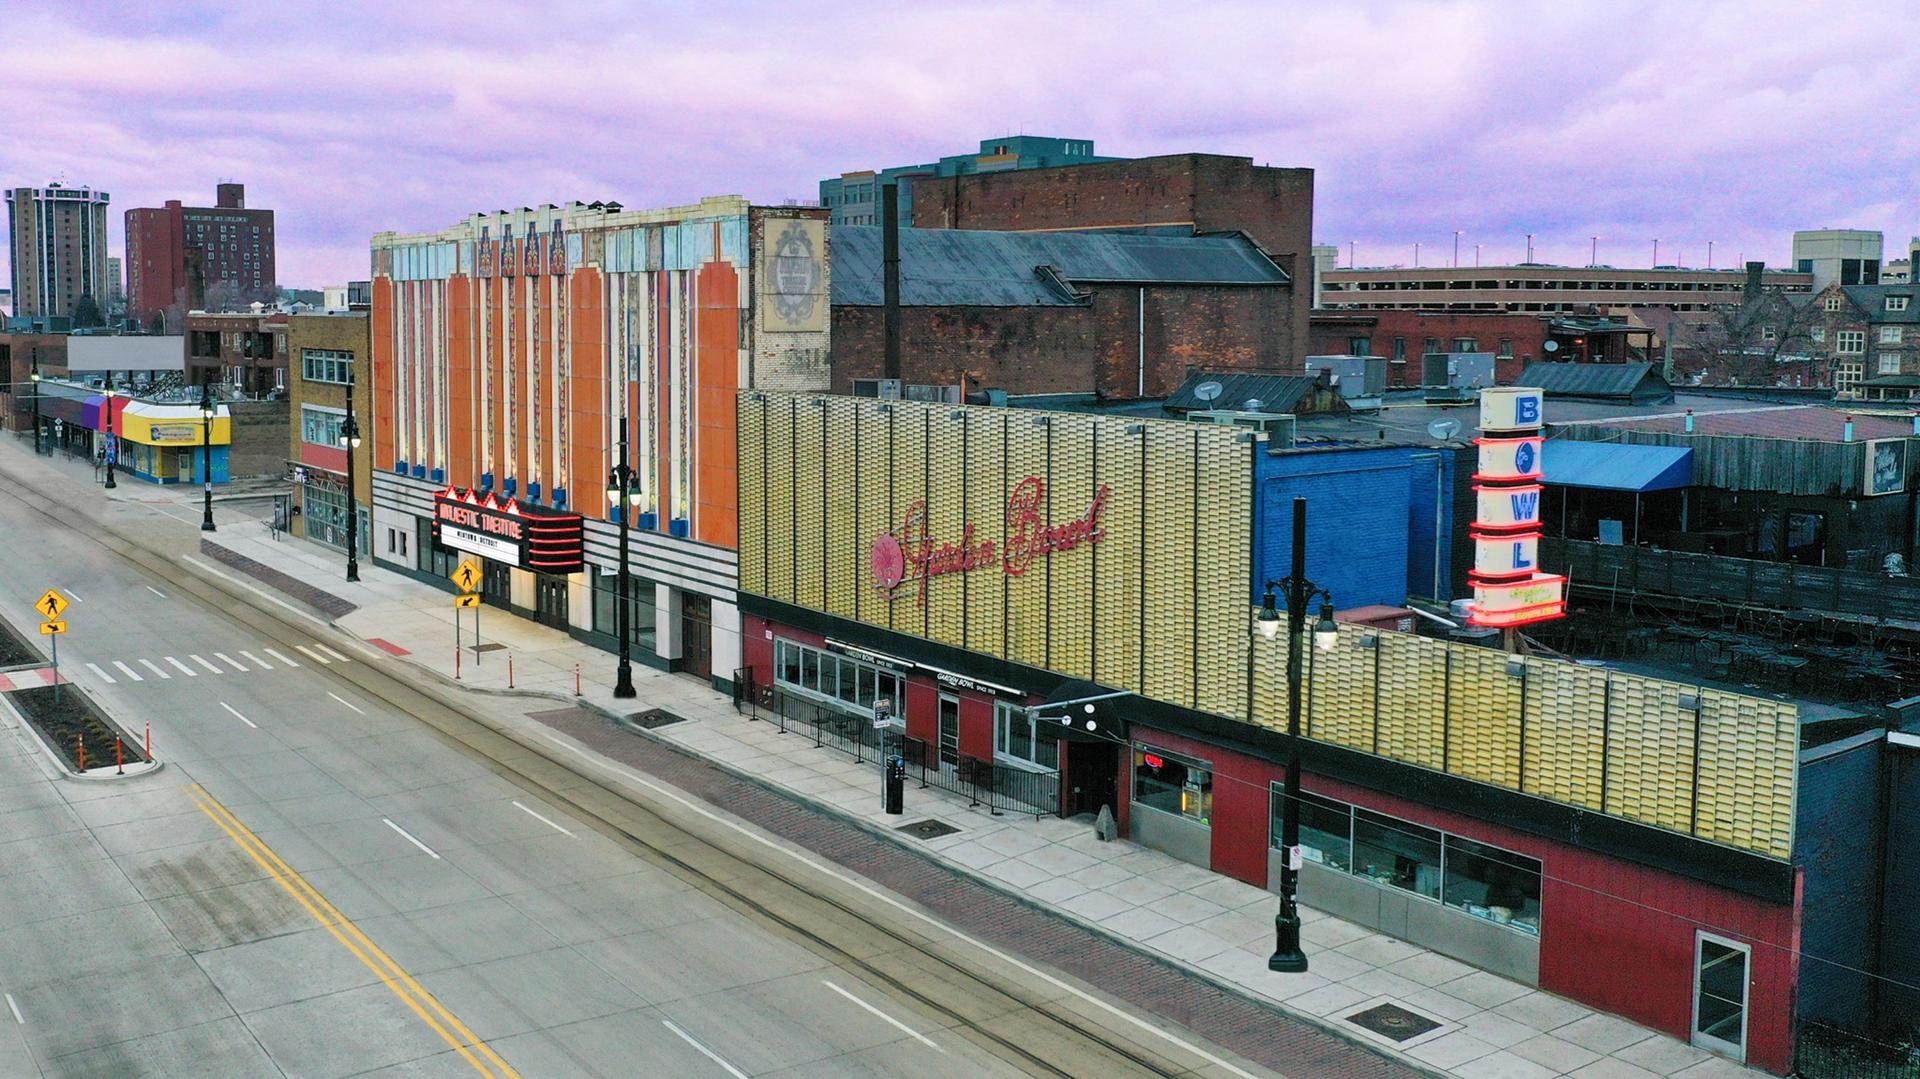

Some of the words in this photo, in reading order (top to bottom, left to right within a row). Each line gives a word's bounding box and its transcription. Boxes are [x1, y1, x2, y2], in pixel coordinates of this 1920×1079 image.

[1510, 396, 1540, 569] BOWL
[439, 503, 480, 529] MAJESTIC
[481, 513, 523, 540] THEATRE
[1003, 475, 1111, 576] Bowl
[937, 672, 958, 685] GARDEN
[957, 679, 975, 690] BOWL
